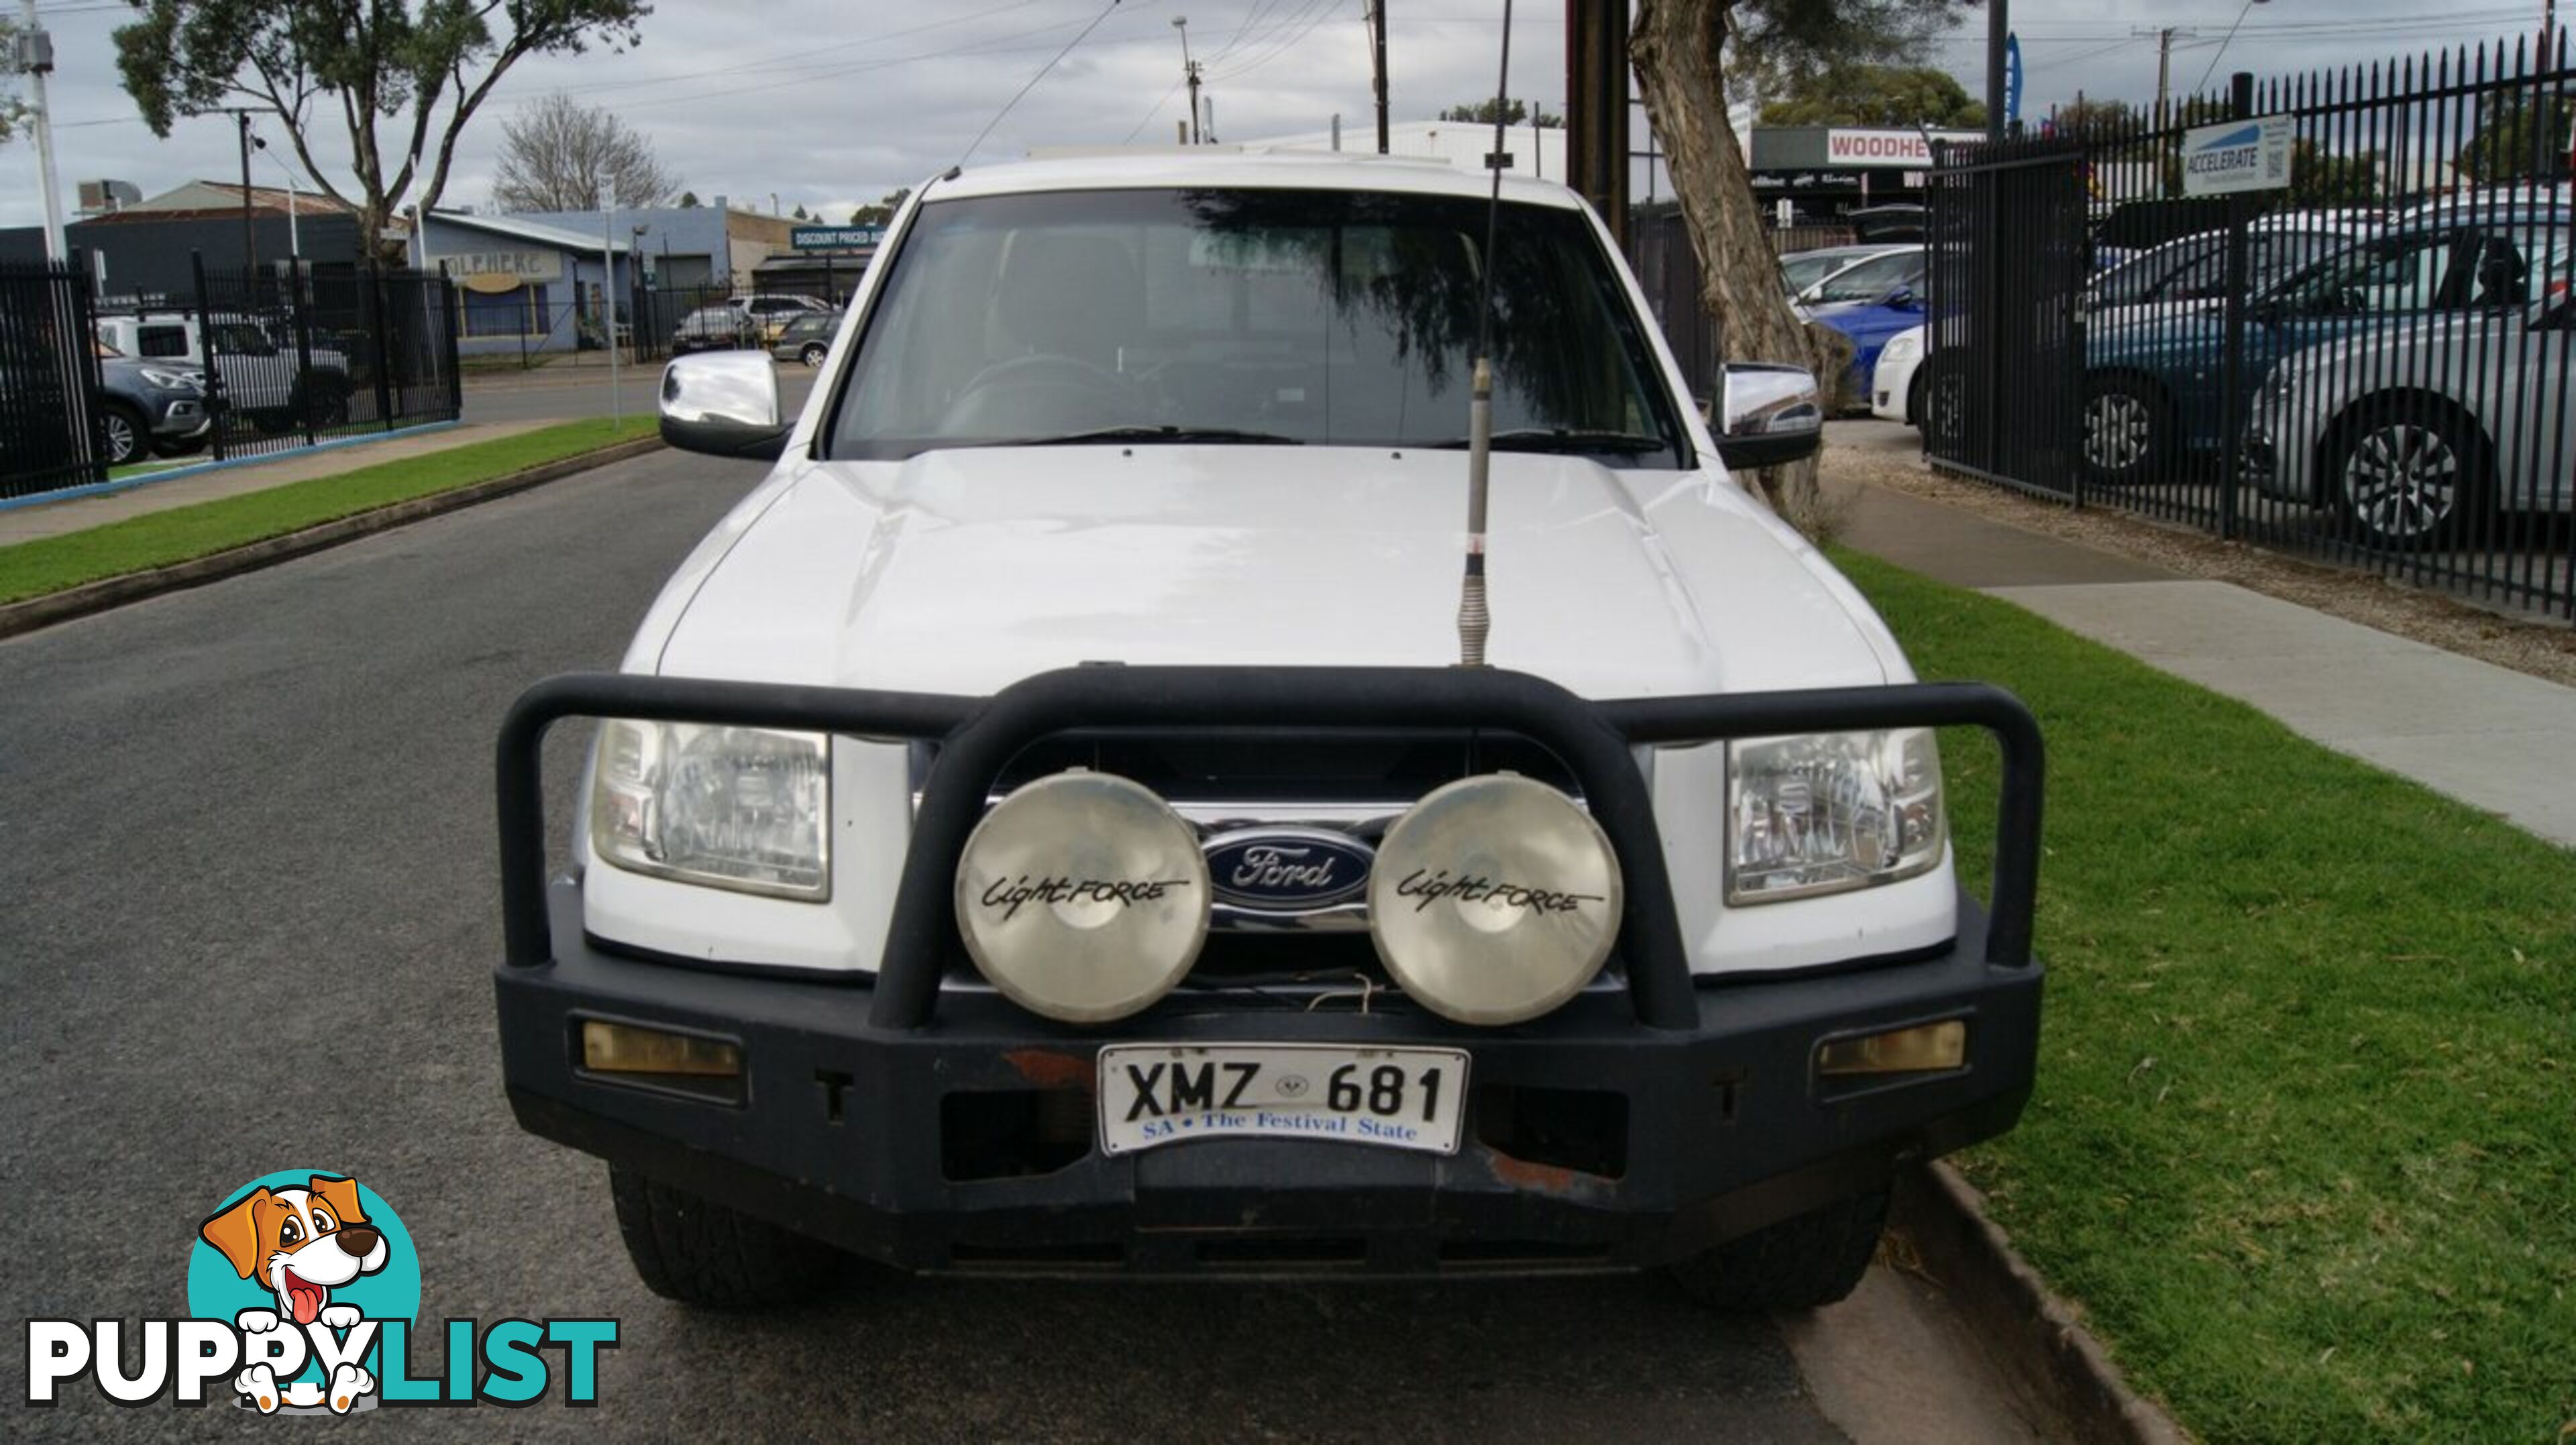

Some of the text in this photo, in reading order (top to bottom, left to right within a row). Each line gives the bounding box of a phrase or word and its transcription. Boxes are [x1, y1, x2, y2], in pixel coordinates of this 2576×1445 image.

[1832, 136, 1932, 158] WOODHE
[2188, 147, 2258, 173] ACCELERATE
[796, 232, 837, 245] DISCOUNT
[839, 231, 869, 245] PRICED
[1232, 846, 1336, 886] Ford
[1125, 1062, 1442, 1122] XMZ 681
[1143, 1112, 1418, 1140] SA The Festival State
